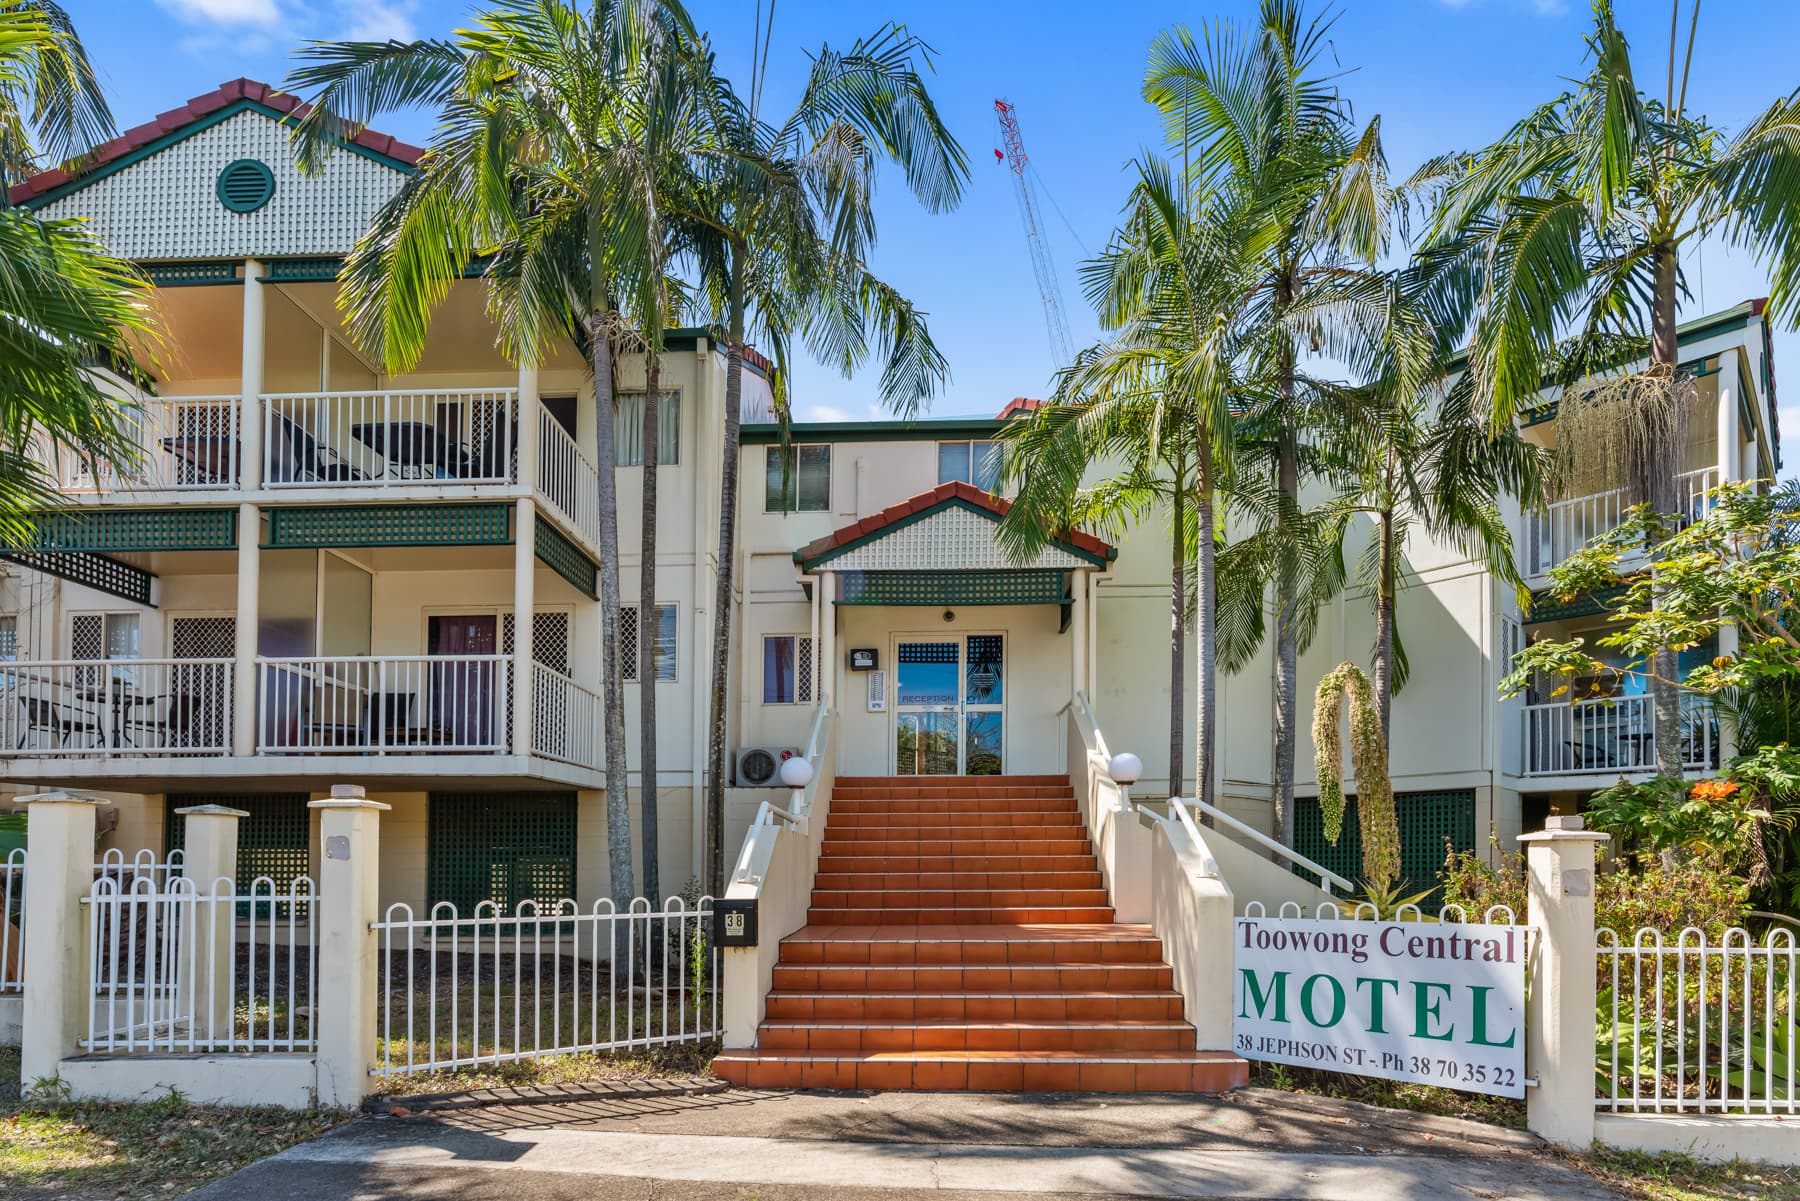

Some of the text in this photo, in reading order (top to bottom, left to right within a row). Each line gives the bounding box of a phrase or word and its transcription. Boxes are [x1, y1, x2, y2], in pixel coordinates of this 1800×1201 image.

[902, 695, 954, 703] RECEPTION
[727, 915, 742, 927] 38
[1238, 921, 1516, 963] Toowong Central
[1238, 968, 1516, 1048] MOTEL
[1236, 1033, 1253, 1051] 38
[1256, 1036, 1337, 1062] JEPHSON
[1382, 1052, 1404, 1072] Ph
[1410, 1056, 1431, 1076] 38
[1437, 1059, 1458, 1079] 70
[1464, 1063, 1486, 1083] 35
[1493, 1067, 1515, 1088] 22
